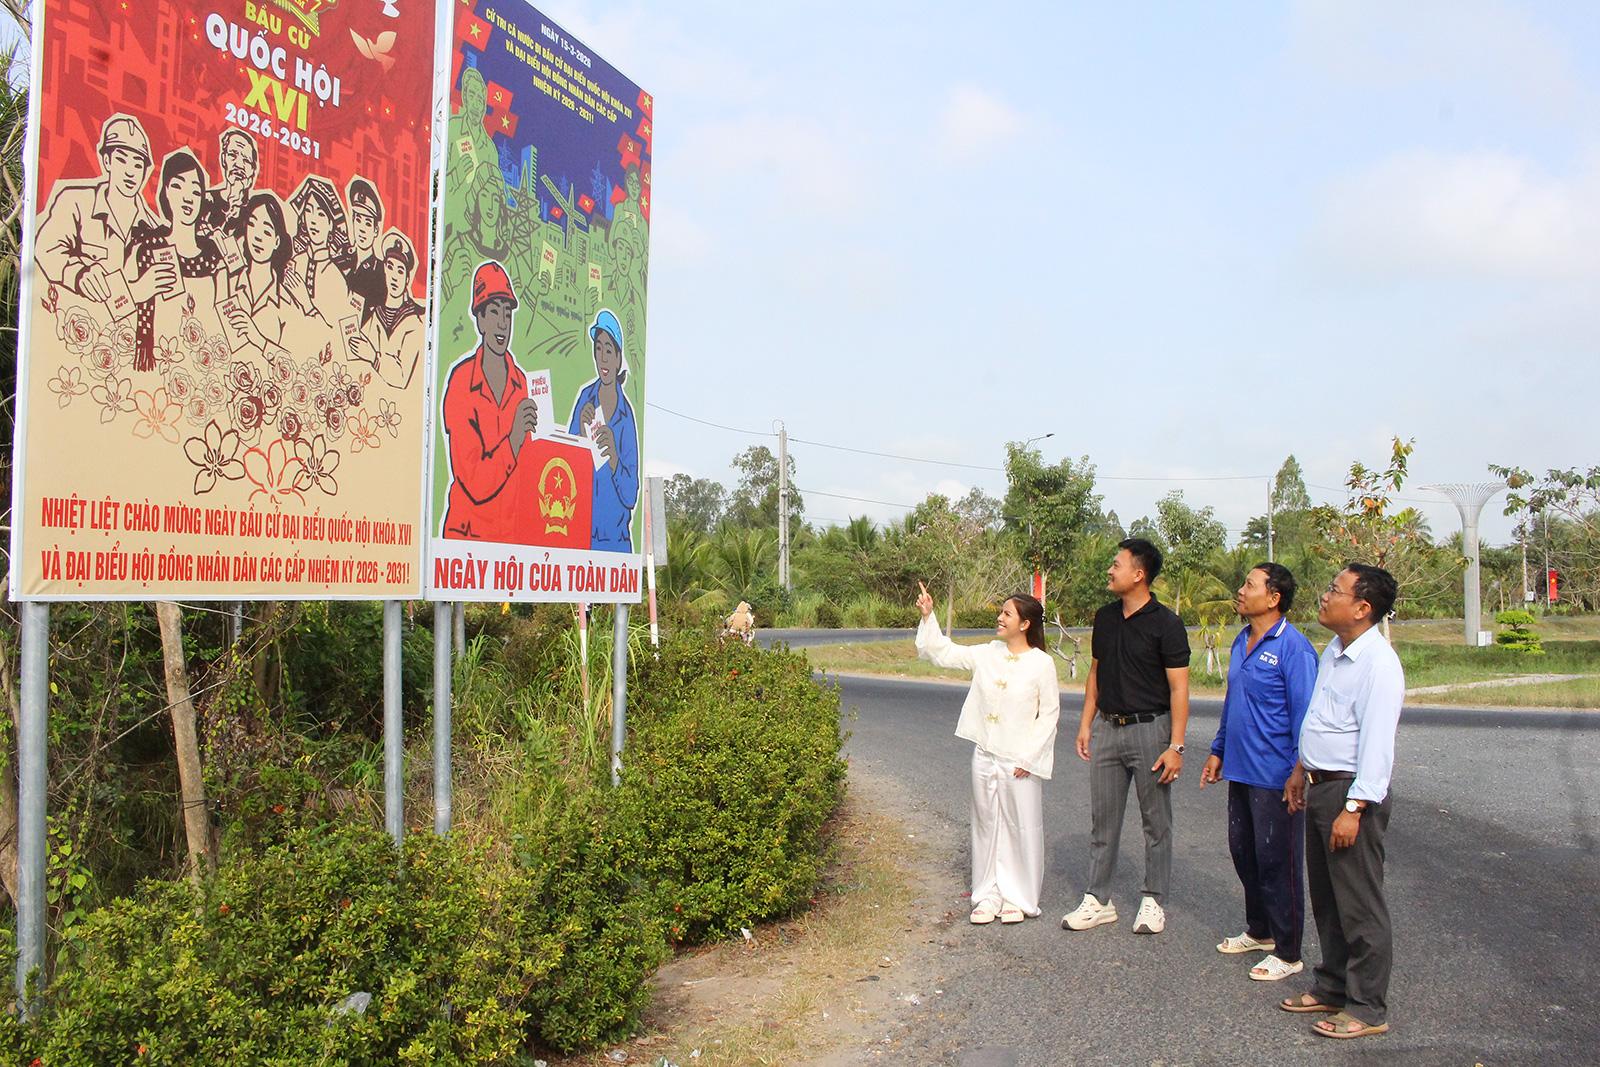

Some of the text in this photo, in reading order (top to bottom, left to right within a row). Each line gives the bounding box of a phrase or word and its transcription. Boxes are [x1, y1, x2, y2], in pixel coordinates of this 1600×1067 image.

[245, 1, 312, 50] BẦU CỬ
[541, 23, 559, 44] NGÀY
[205, 13, 340, 108] QUỐC HỘI
[243, 67, 308, 132] XVI
[224, 102, 320, 160] 2026-2031
[41, 492, 412, 548] NHIỆT LIỆT CHÀO MỪNG NGÀY BẦU CỬ ĐẠI BIỂU QUỐC HỘI KHÓA XVI
[41, 544, 62, 581] VÀ
[66, 551, 92, 587] ĐẠI
[95, 540, 128, 581] BIỂU
[132, 547, 155, 587] HỘI
[158, 545, 193, 582] ĐỒNG
[196, 550, 230, 582] NHÂN
[233, 551, 258, 582] DÂN
[260, 552, 282, 583] CÁC
[285, 549, 306, 583] CẤP
[308, 554, 340, 589] NHIỆM
[341, 555, 355, 584] KỲ
[356, 560, 379, 584] 2026
[386, 561, 410, 585] 2031!
[434, 552, 638, 597] NGÀY HỘI CỦA TOÀN DÂN
